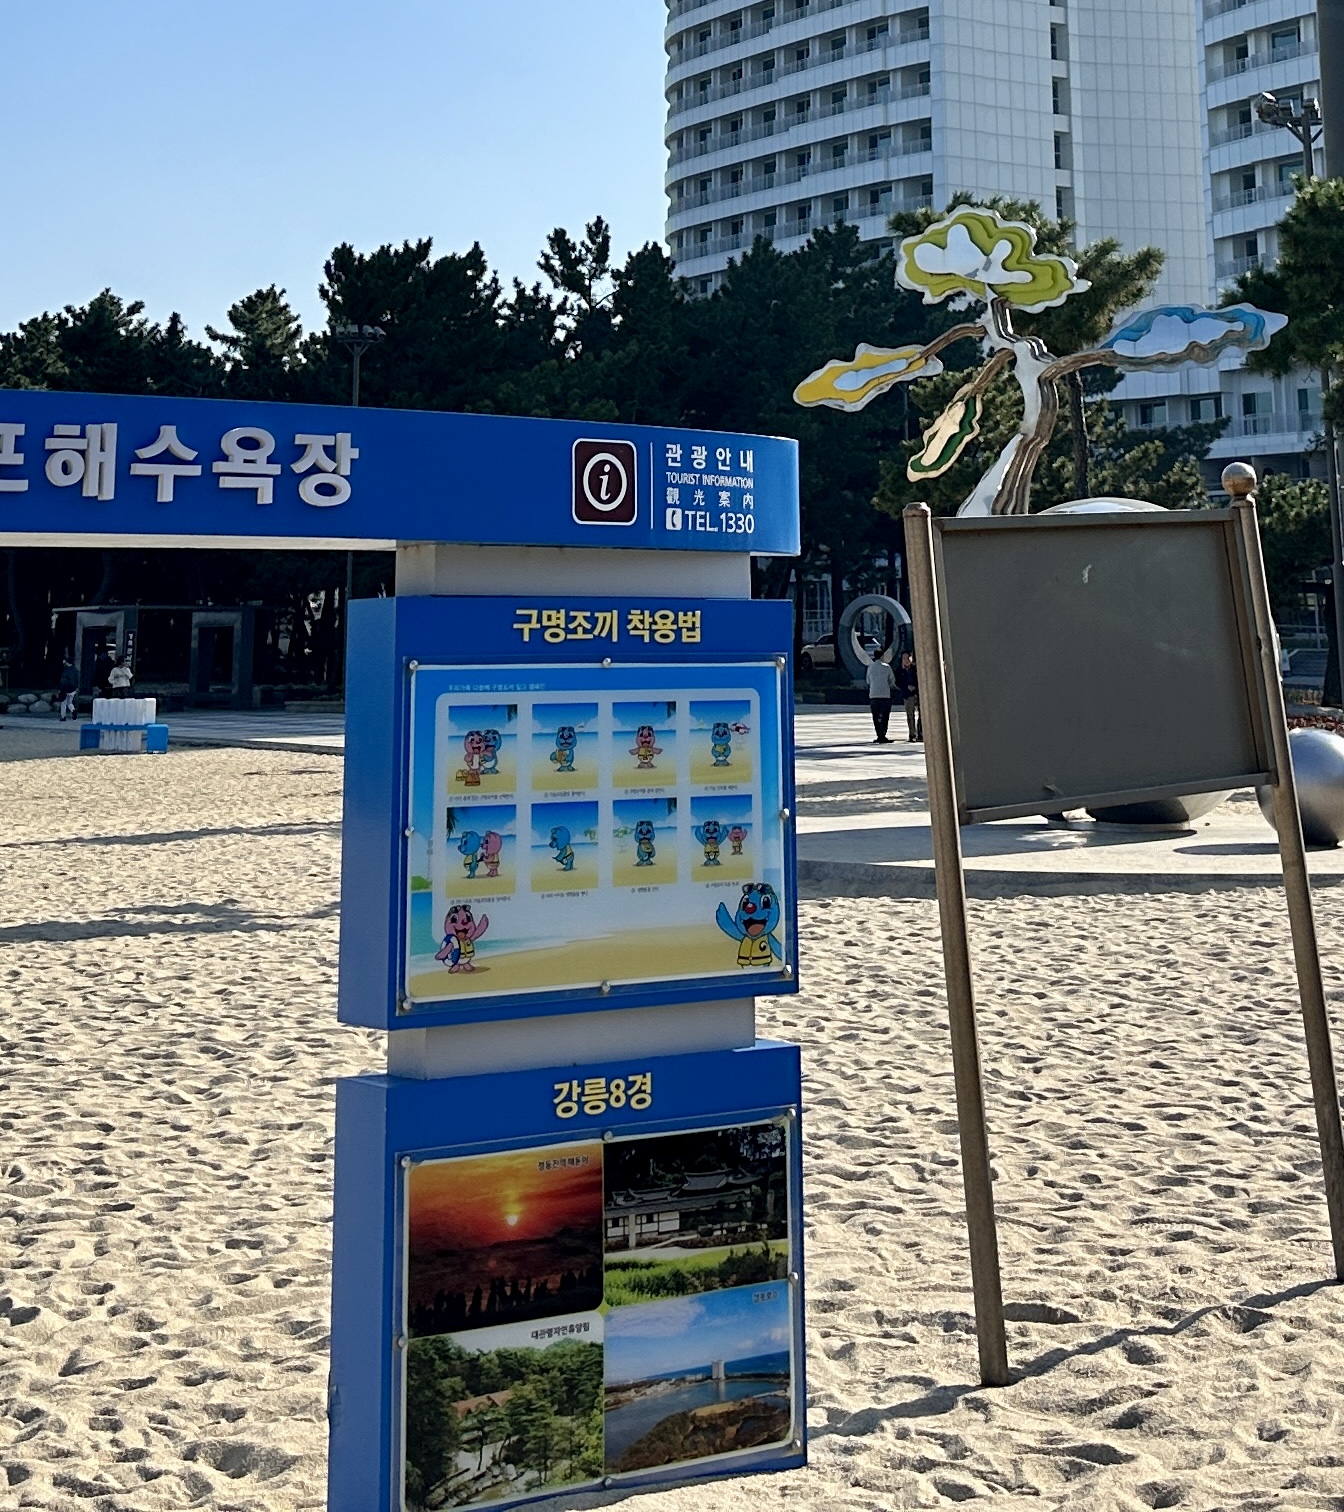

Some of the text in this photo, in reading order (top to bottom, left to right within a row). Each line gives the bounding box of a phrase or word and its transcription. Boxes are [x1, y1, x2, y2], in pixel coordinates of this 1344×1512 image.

[665, 471, 754, 489] TOURIST INFORMATION
[512, 607, 702, 644] 구명조끼 착용법
[552, 1071, 653, 1120] 강릉8경
